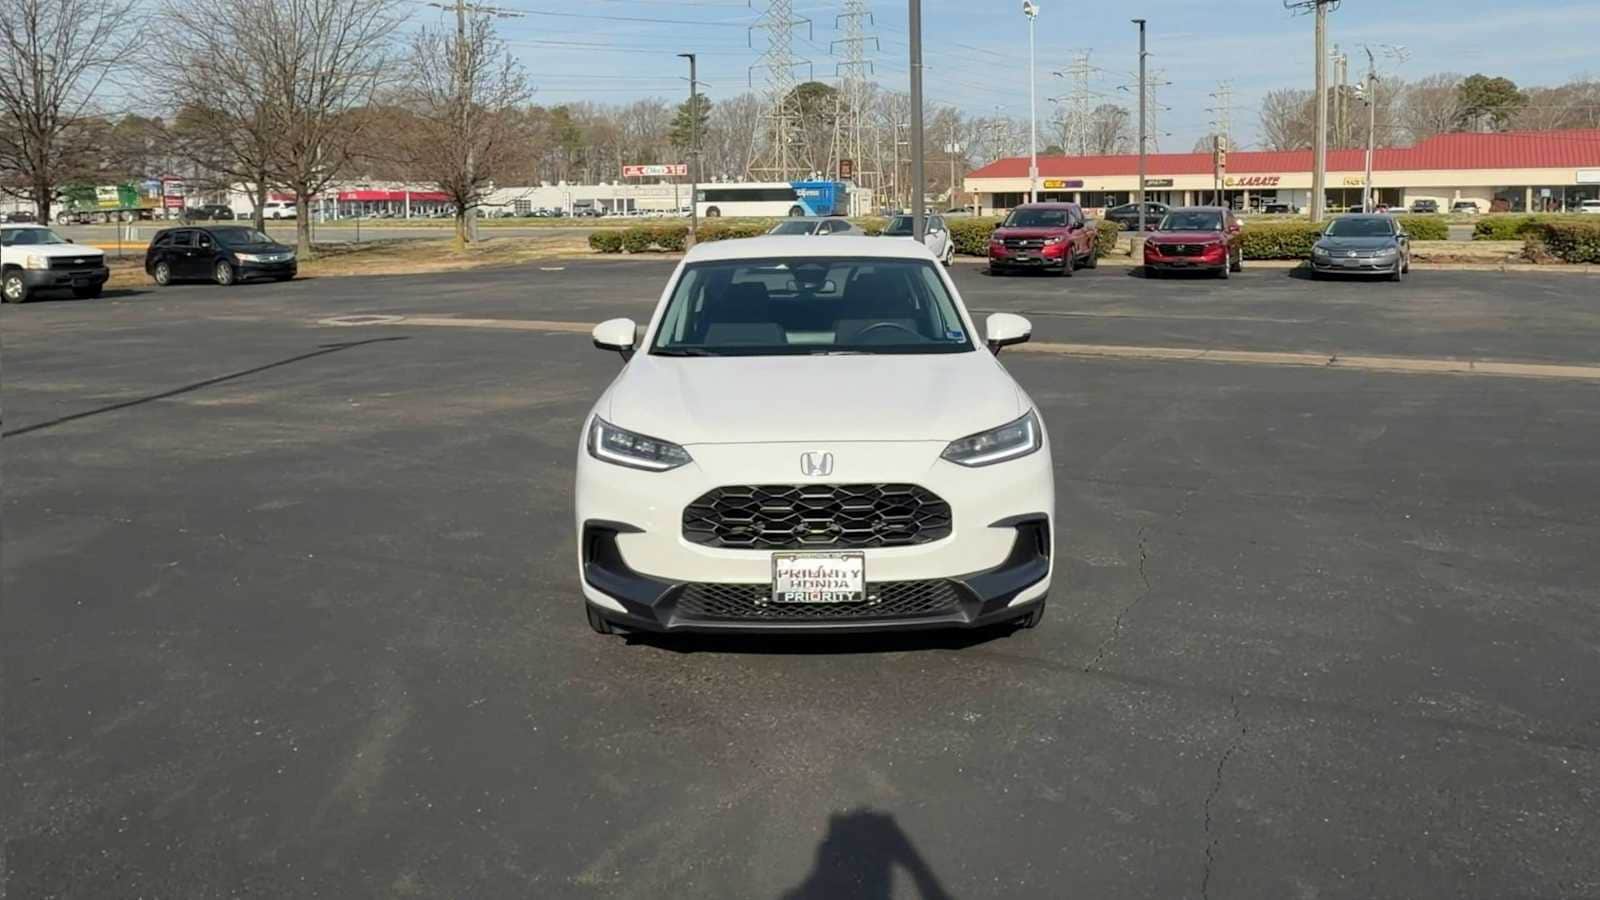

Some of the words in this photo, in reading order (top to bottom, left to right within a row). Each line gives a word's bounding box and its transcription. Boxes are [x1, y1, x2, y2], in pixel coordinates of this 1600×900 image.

[1237, 176, 1280, 186] KARATE
[778, 568, 861, 579] PRIORITY
[790, 579, 849, 589] HONDA
[785, 592, 855, 602] PRIORITY
